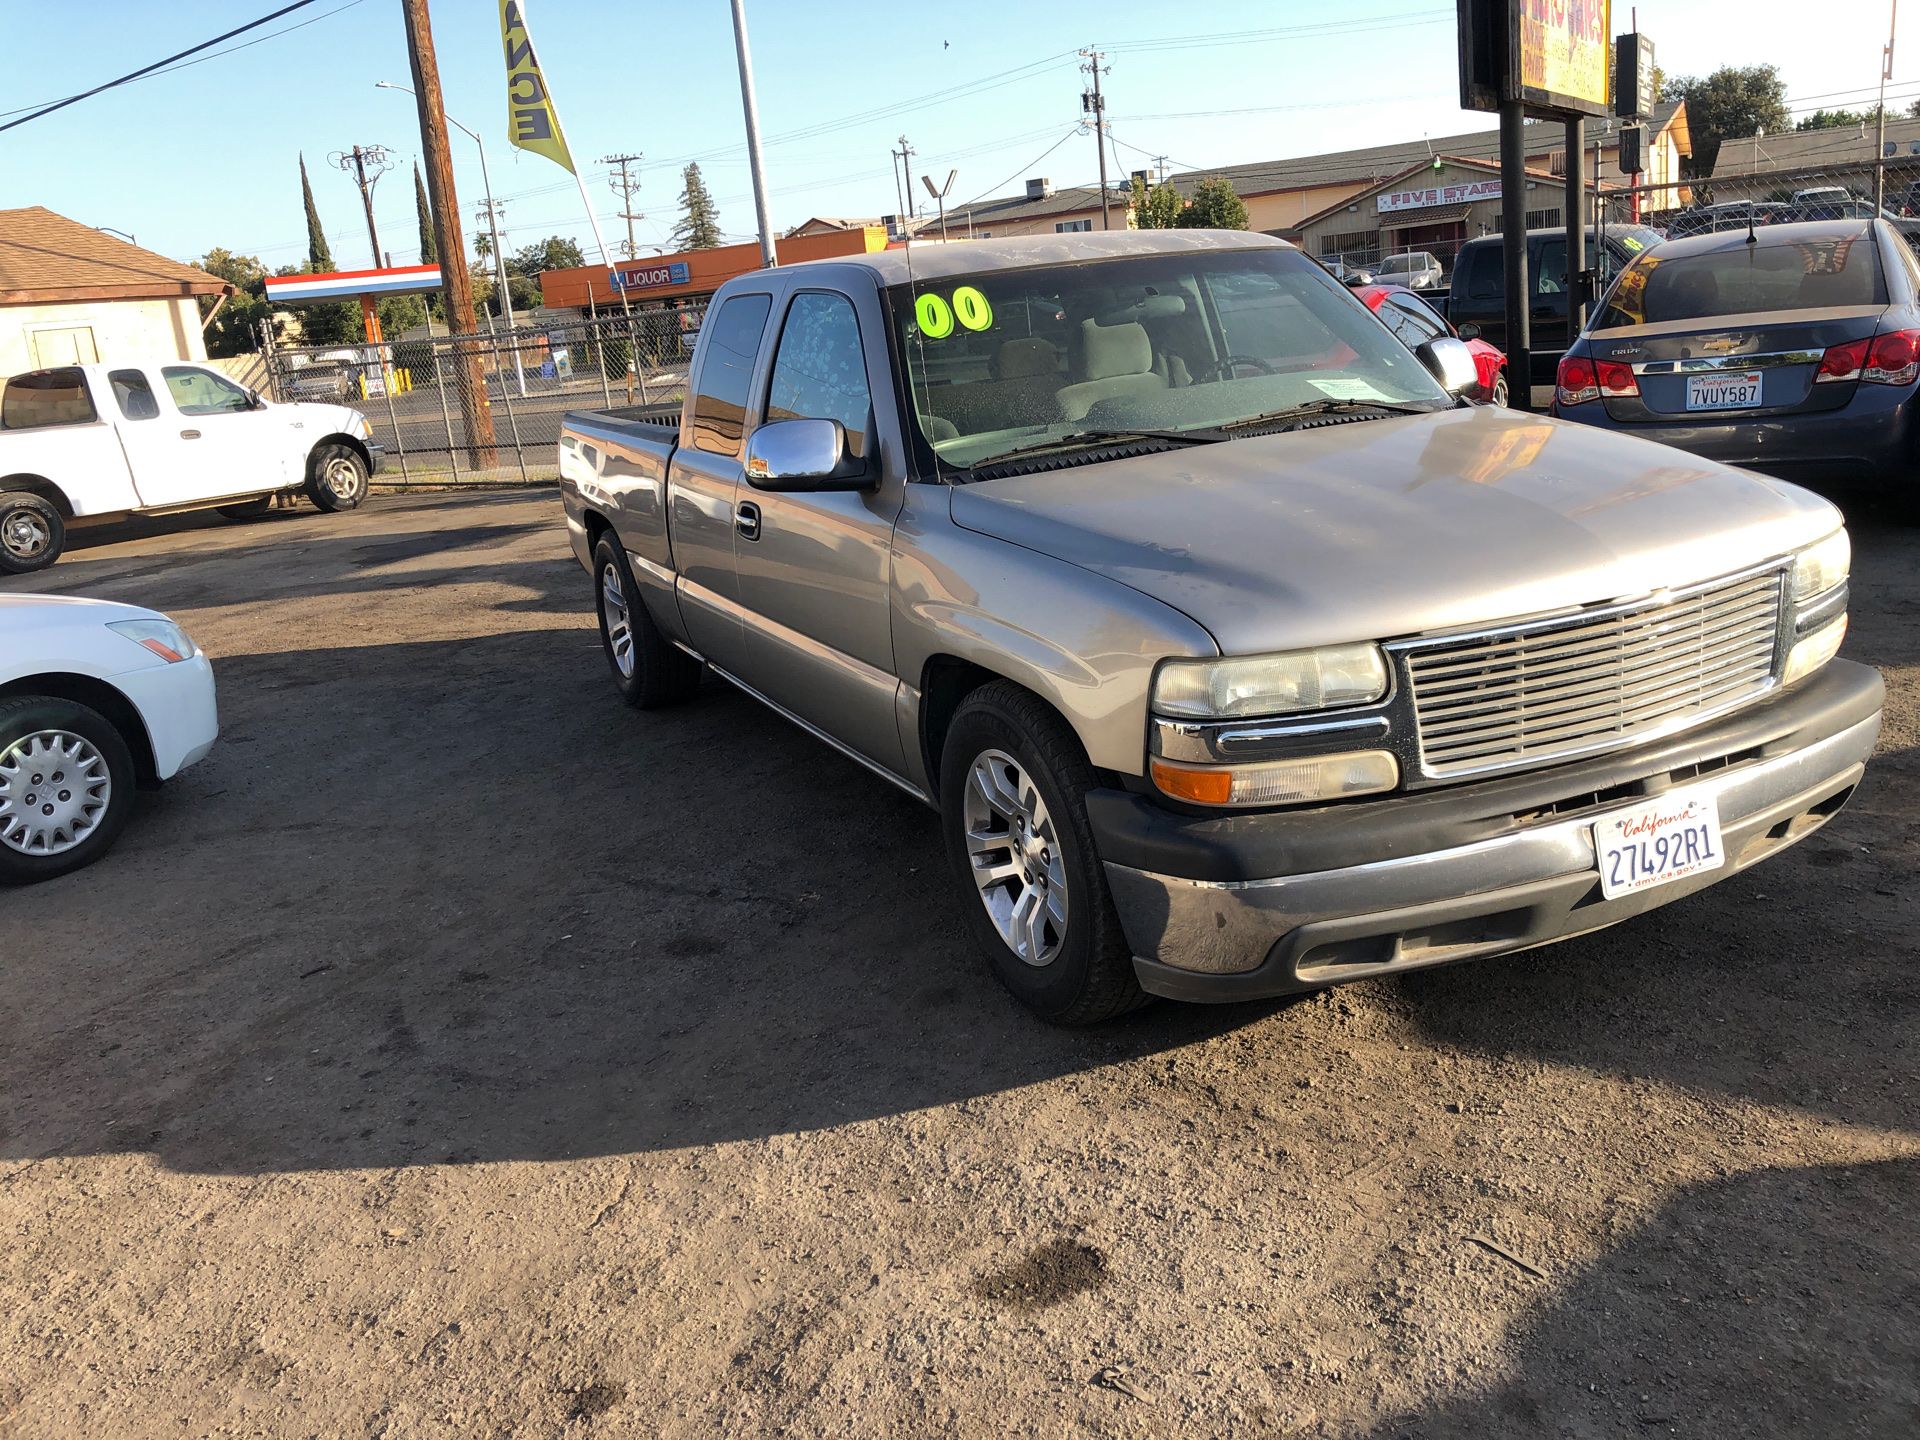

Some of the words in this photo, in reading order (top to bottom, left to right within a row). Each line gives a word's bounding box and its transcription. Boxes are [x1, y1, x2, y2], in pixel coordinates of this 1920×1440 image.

[1391, 189, 1437, 206] FIVE
[624, 269, 671, 287] LIQUOR
[914, 286, 993, 339] 00
[1692, 385, 1757, 405] 7VUY587
[1623, 808, 1696, 839] California
[1607, 823, 1715, 887] 27492R1
[1635, 864, 1696, 887] dmv.ca.gov
